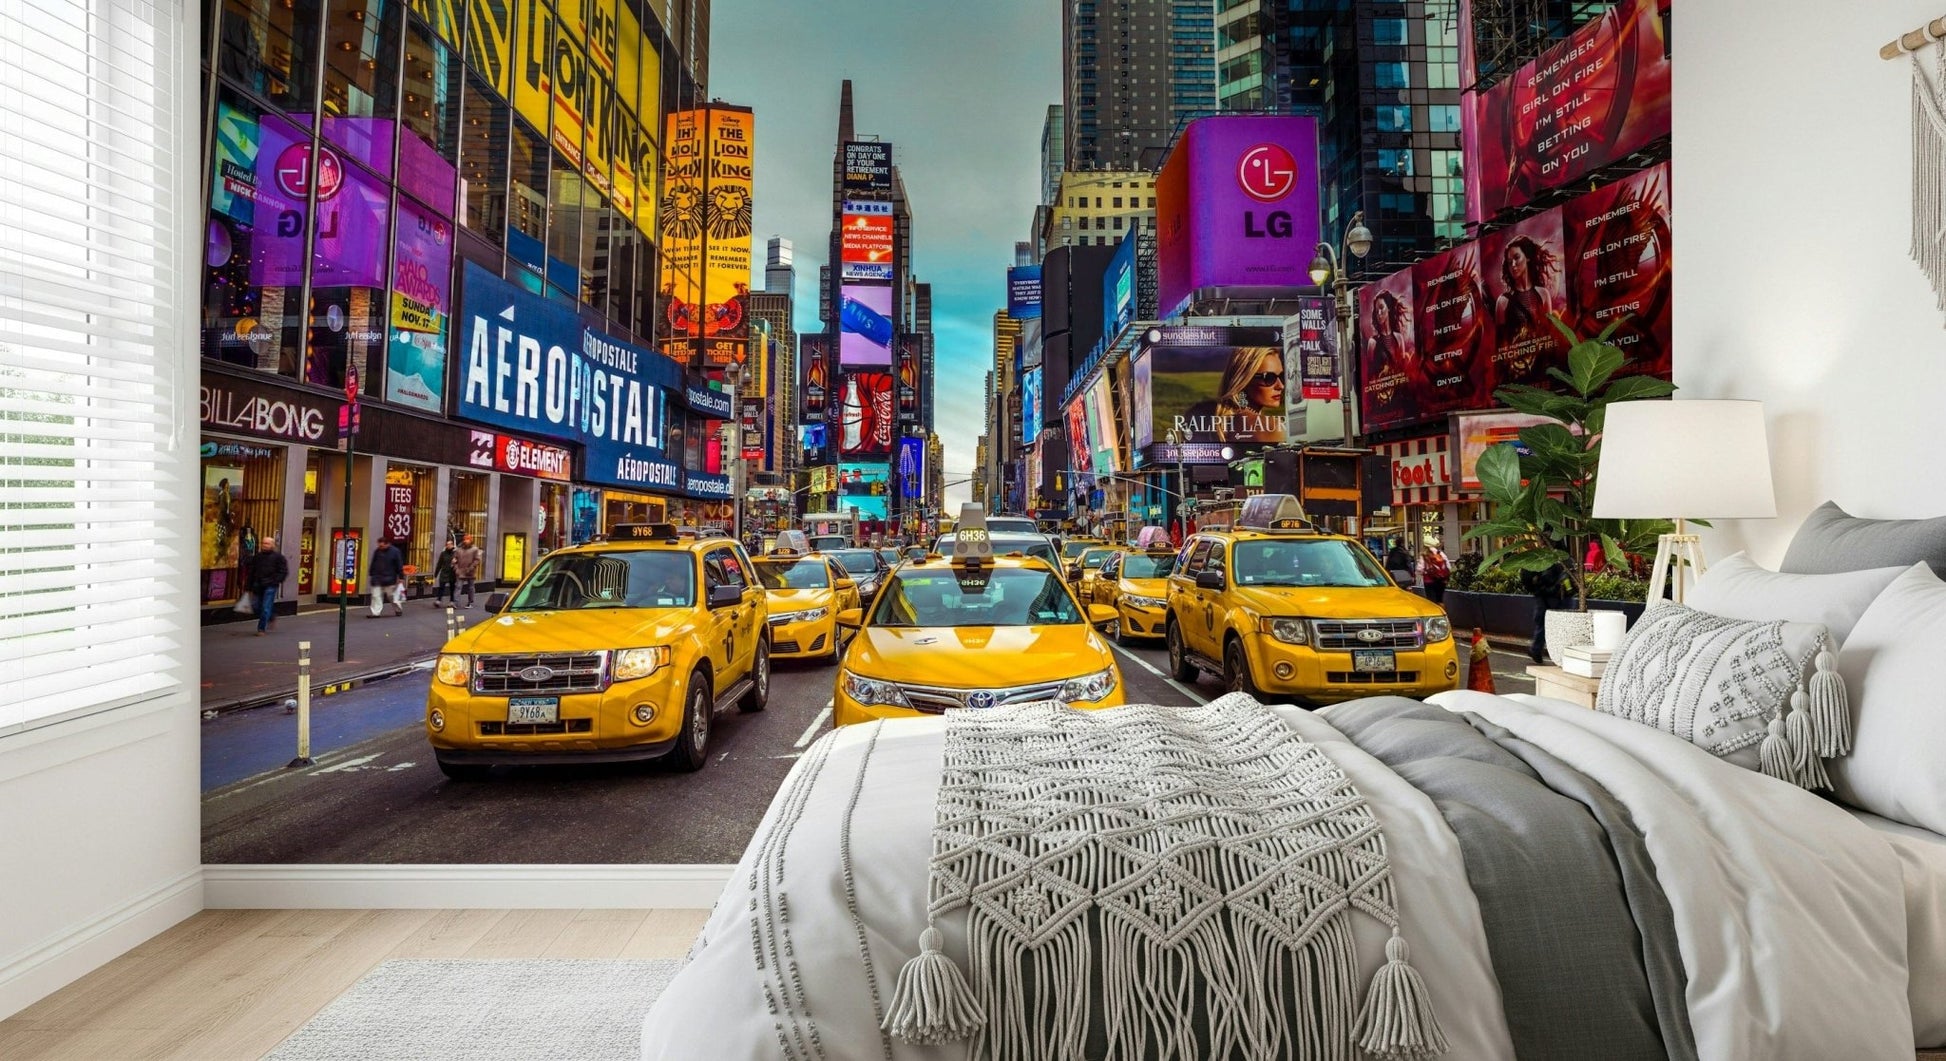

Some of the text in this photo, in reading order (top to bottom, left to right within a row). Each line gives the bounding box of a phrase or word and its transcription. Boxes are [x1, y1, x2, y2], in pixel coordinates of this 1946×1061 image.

[1527, 38, 1595, 89] REMEMBER
[1522, 57, 1604, 115] GIRL ON FIRE
[1535, 93, 1592, 131] I'M STILL
[718, 127, 743, 140] THE
[1537, 116, 1592, 153] BETTING
[714, 140, 748, 157] LION
[1542, 143, 1590, 175] ON YOU
[226, 163, 251, 182] Hosted
[711, 159, 751, 178] KING
[230, 182, 252, 198] NICK
[1585, 201, 1641, 229] REMEMBER
[1244, 210, 1293, 239] LG
[1583, 232, 1647, 260] GIRL ON FIRE
[710, 255, 747, 263] REMEMBER
[718, 263, 750, 271] FOREVER.
[1427, 269, 1463, 288] REMEMBER
[1594, 268, 1638, 289] I'M STILL
[1426, 294, 1468, 313] GIRL ON FIRE
[1596, 301, 1640, 319] BETTING
[401, 311, 421, 327] NOV.
[1301, 309, 1323, 320] SOME
[1301, 319, 1327, 330] WALLS
[1443, 323, 1462, 334] STILL
[1162, 330, 1216, 342] sunglass hut
[1617, 334, 1639, 347] YOU
[582, 326, 638, 374] AÉROPOSTALE
[716, 342, 733, 350] GET
[1434, 348, 1463, 362] BETTING
[1491, 345, 1536, 363] CATCHING
[1365, 379, 1395, 393] CATCHING
[1436, 375, 1462, 387] ON YOU
[200, 386, 325, 440] BILLABONG
[1174, 415, 1236, 432] RALPH
[519, 446, 564, 474] ELEMENT
[617, 452, 677, 486] AÉROPOSTALE
[1392, 458, 1435, 487] Foot
[390, 487, 412, 503] TEES
[394, 504, 399, 512] 3
[388, 514, 411, 537] $33
[632, 526, 653, 537] 9Y68
[960, 530, 985, 541] 6H36
